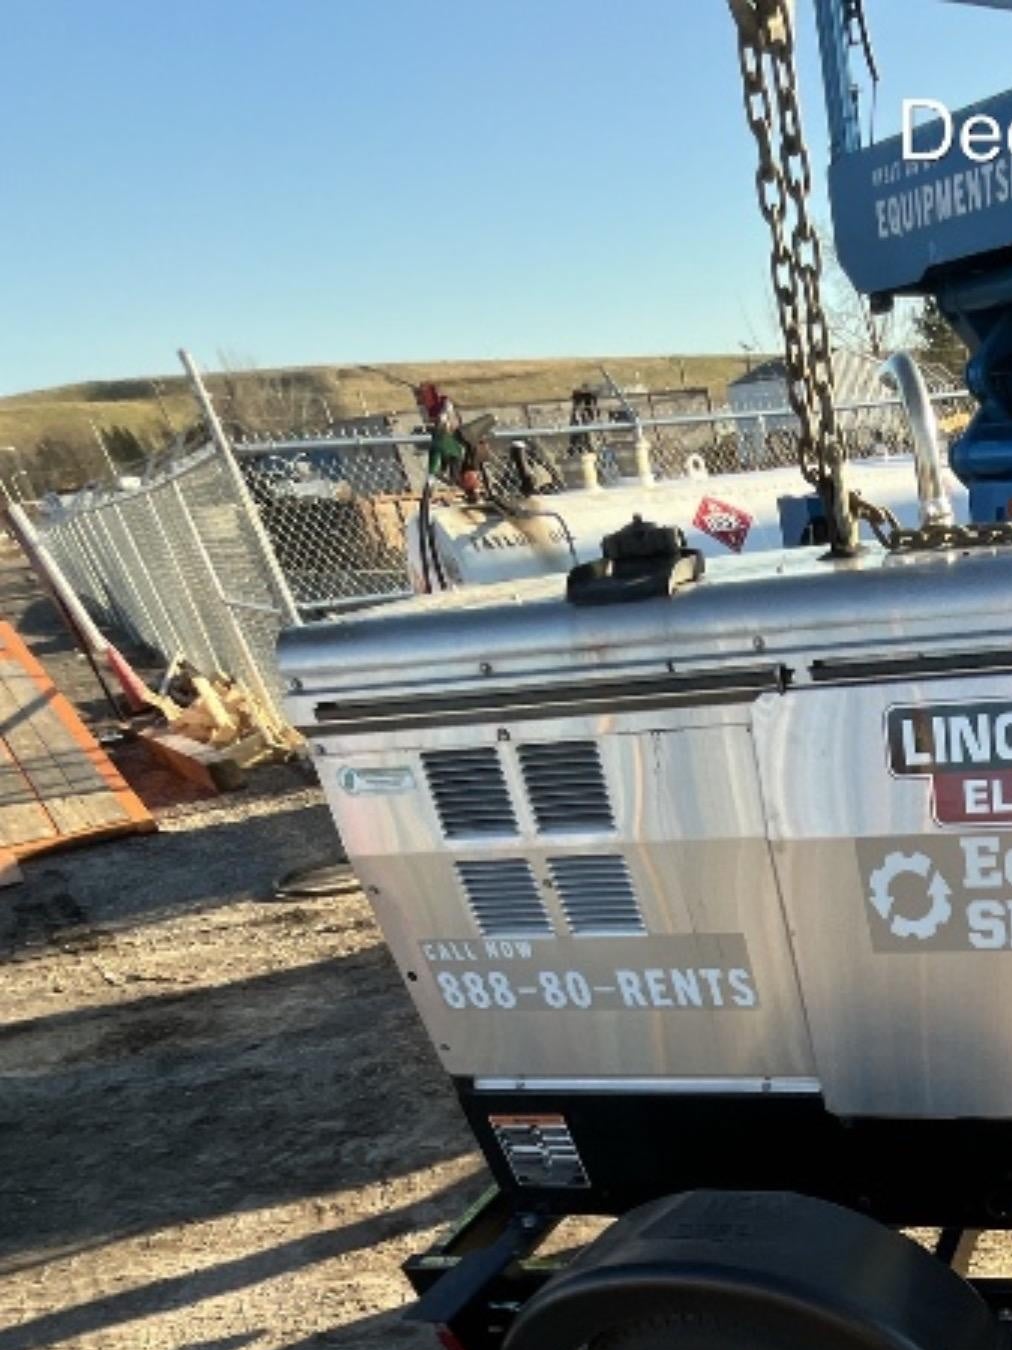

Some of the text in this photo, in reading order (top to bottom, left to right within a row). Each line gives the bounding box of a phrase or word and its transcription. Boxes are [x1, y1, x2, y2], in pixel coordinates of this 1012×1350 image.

[423, 940, 533, 961] CALL NOW
[437, 968, 757, 1010] 888-80-RENTS
